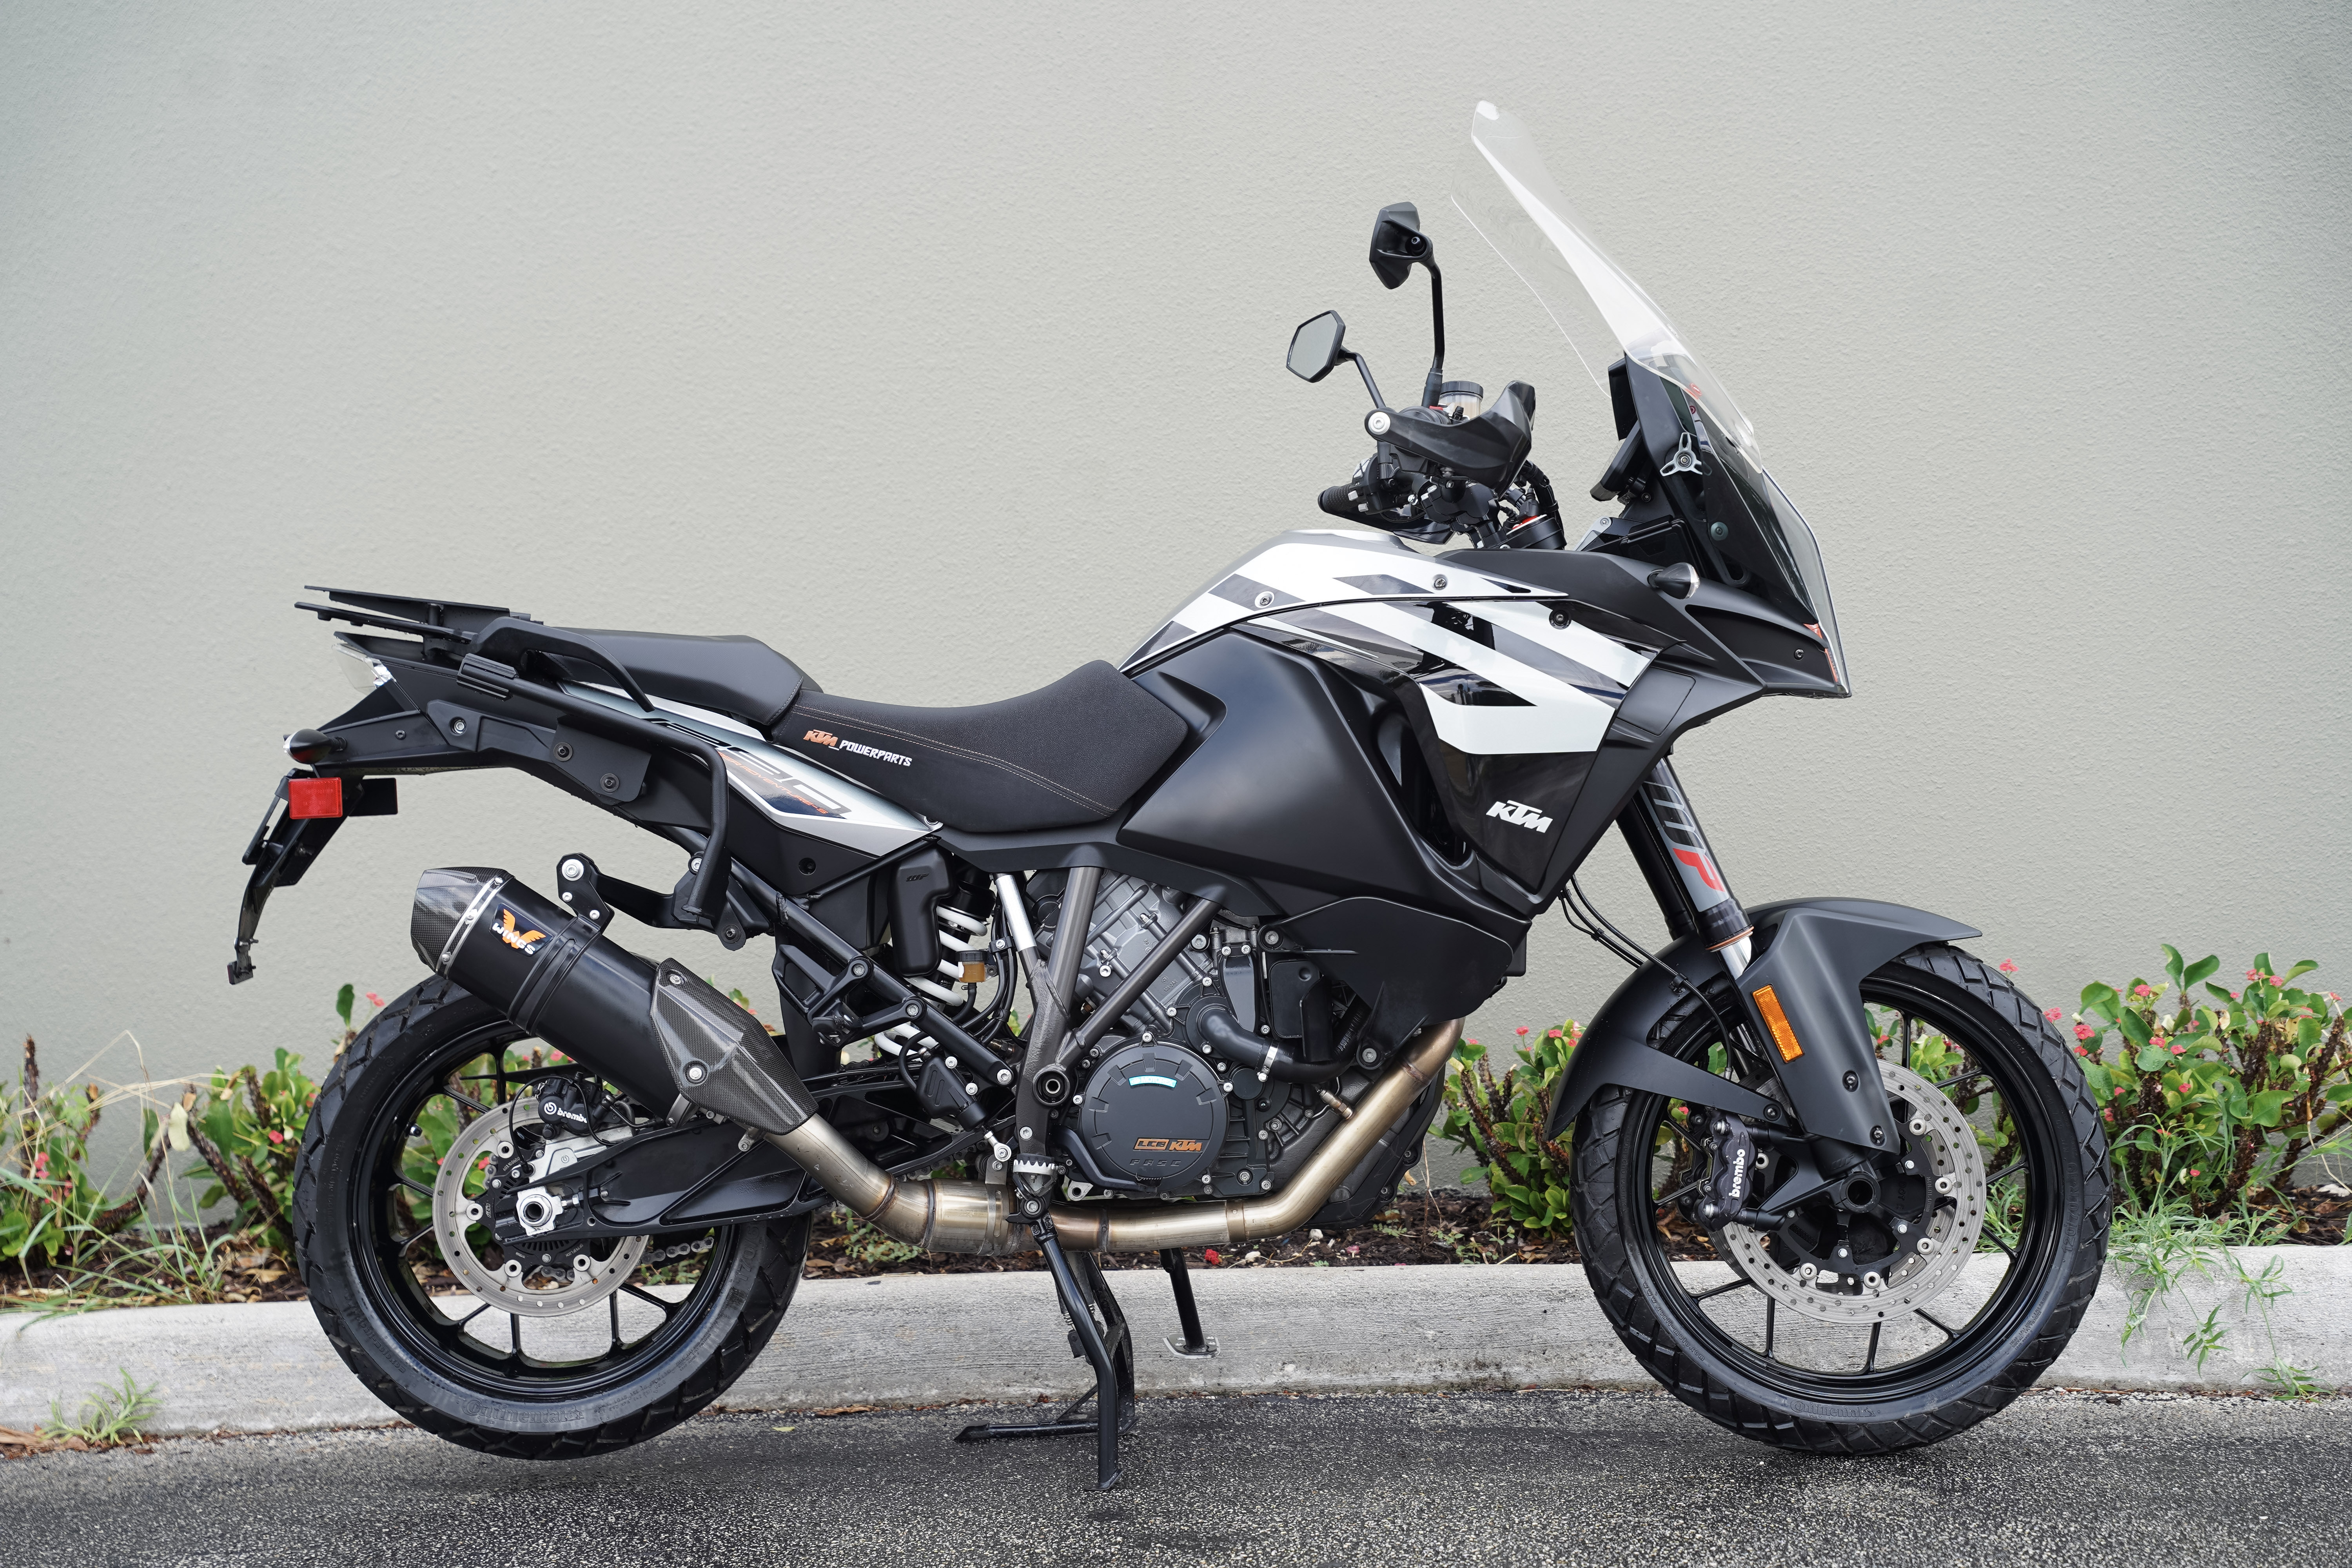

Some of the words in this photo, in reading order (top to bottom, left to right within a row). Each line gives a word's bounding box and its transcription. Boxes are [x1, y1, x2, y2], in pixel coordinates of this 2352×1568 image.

[1486, 800, 1553, 833] KTM
[492, 922, 535, 955] WINGS
[1169, 1140, 1202, 1151] KTM
[1729, 1149, 1746, 1198] brembo
[737, 1225, 760, 1283] 170/6
[1642, 1281, 1706, 1362] www.conti-moto.com
